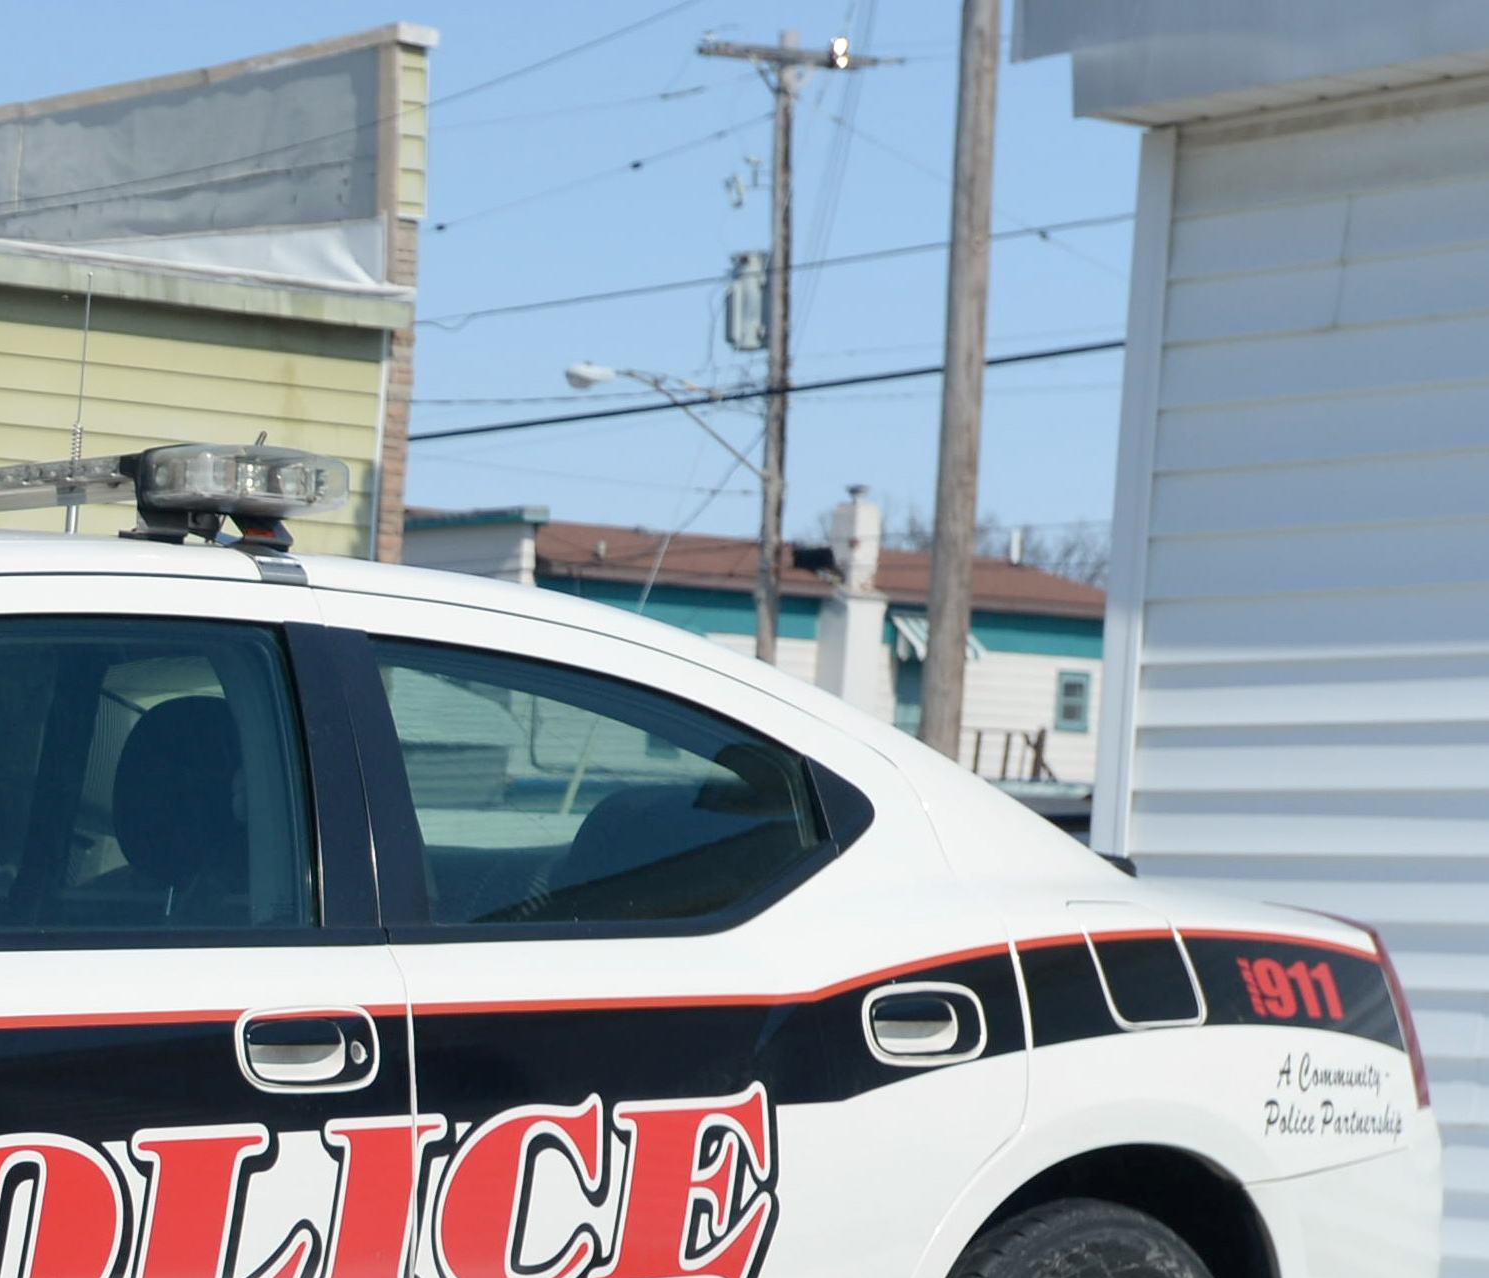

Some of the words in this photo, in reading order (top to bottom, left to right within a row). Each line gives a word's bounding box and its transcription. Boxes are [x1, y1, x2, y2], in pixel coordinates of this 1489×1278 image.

[1252, 957, 1344, 1020] 911
[1277, 1052, 1292, 1089] A
[1298, 1052, 1382, 1097] Community
[1264, 1099, 1316, 1136] Police
[1320, 1100, 1403, 1143] Partnership
